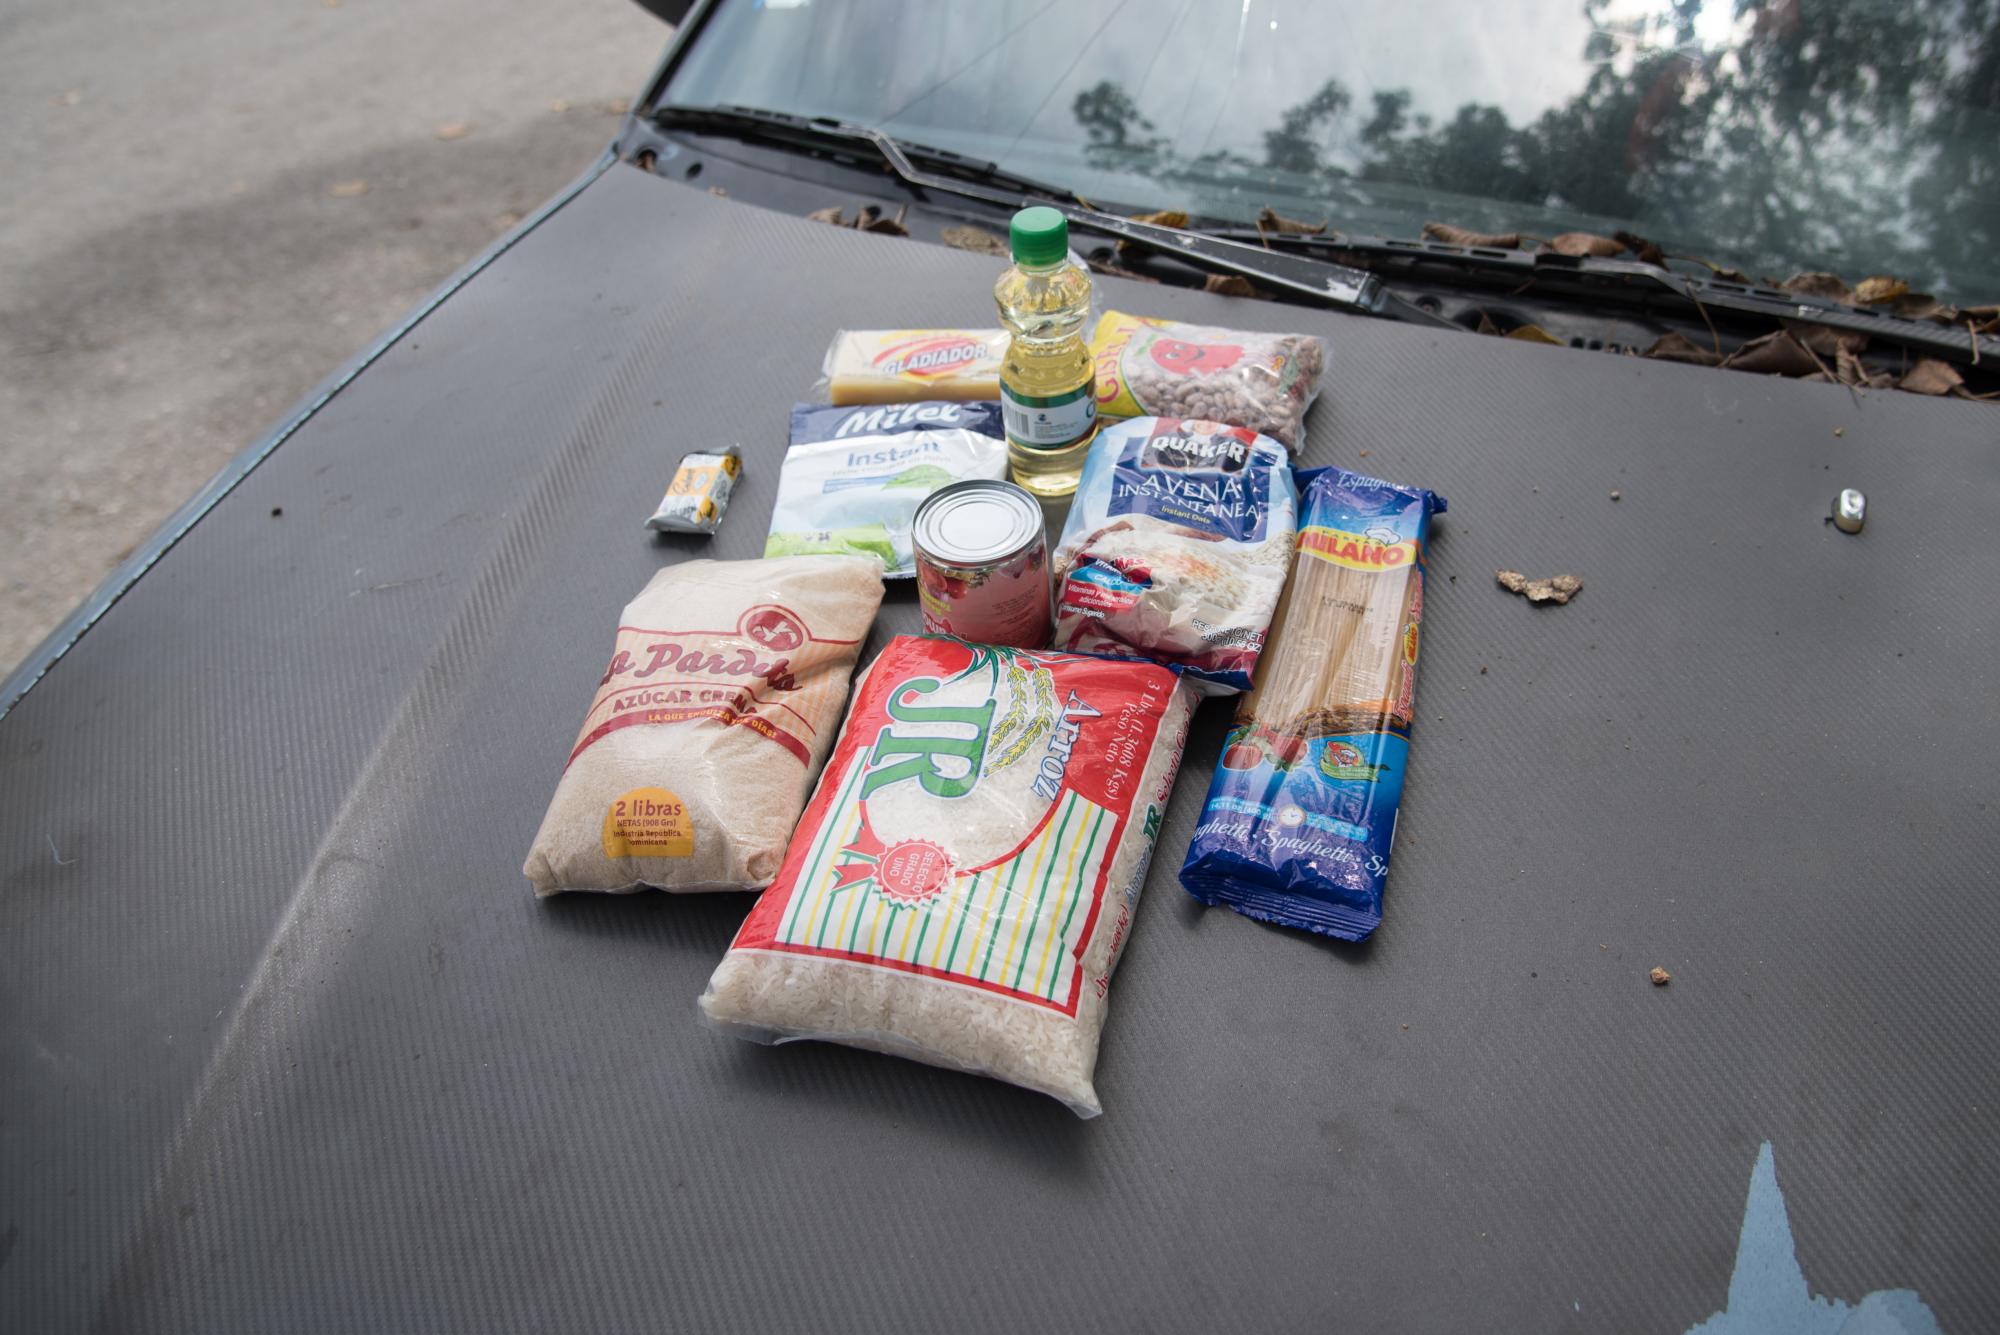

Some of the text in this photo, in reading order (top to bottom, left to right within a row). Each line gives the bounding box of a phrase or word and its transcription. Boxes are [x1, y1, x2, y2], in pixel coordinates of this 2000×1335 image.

[885, 343, 988, 376] GLADIADOR
[847, 442, 941, 467] Instant
[1152, 436, 1246, 464] QUAKER
[1119, 484, 1261, 520] INSTANTANEA
[1143, 474, 1243, 502] AVENA
[1161, 504, 1190, 520] Instant
[1296, 531, 1405, 566] MILANO
[1147, 679, 1161, 691] 3
[613, 689, 758, 714] AZÚCAR CREMA
[649, 713, 661, 722] LA
[664, 712, 685, 722] QUE
[859, 676, 998, 801] JR
[1031, 688, 1102, 801] Arroz
[1104, 702, 1138, 763] Peso Neto
[1119, 718, 1146, 767] (1.3608
[1103, 767, 1129, 800] Kgs)
[616, 800, 682, 817] 2 libras
[617, 818, 677, 828] NETAS (908 Grs)
[627, 838, 668, 847] ominicana
[1261, 829, 1352, 863] Spaghetti
[889, 856, 905, 877] UNO
[900, 852, 920, 886] GRADO
[912, 850, 936, 893] SELECTO
